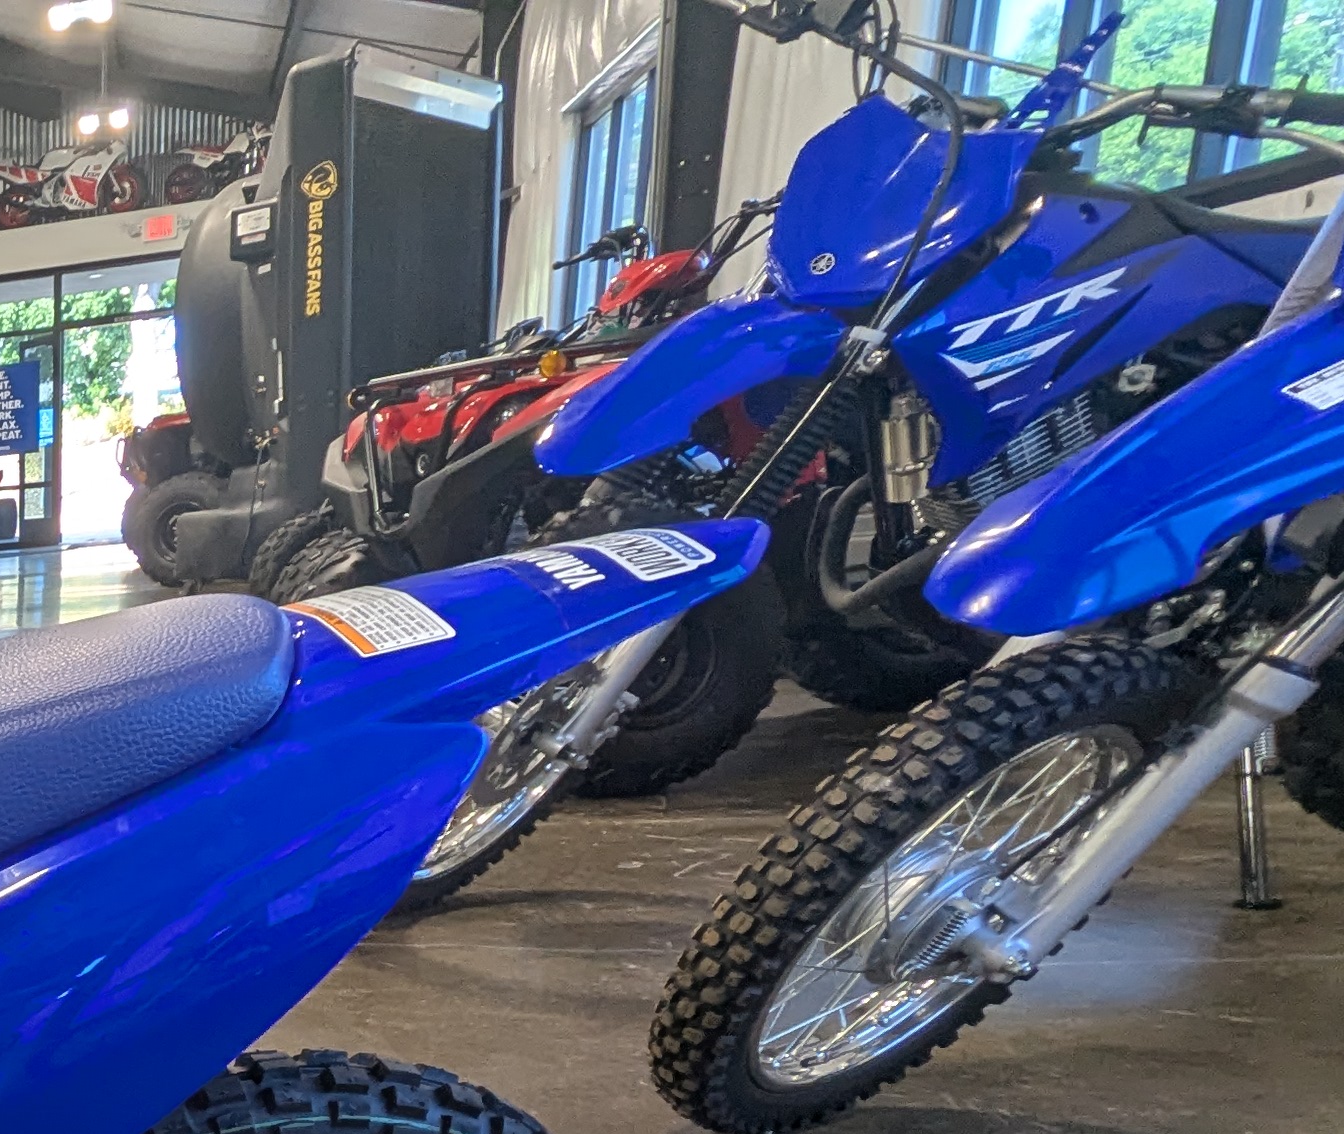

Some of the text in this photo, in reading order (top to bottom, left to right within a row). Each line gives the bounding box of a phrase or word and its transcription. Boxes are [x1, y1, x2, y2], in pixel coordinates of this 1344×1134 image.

[305, 199, 323, 318] BIG ASS FANS
[948, 266, 1128, 351] TTR
